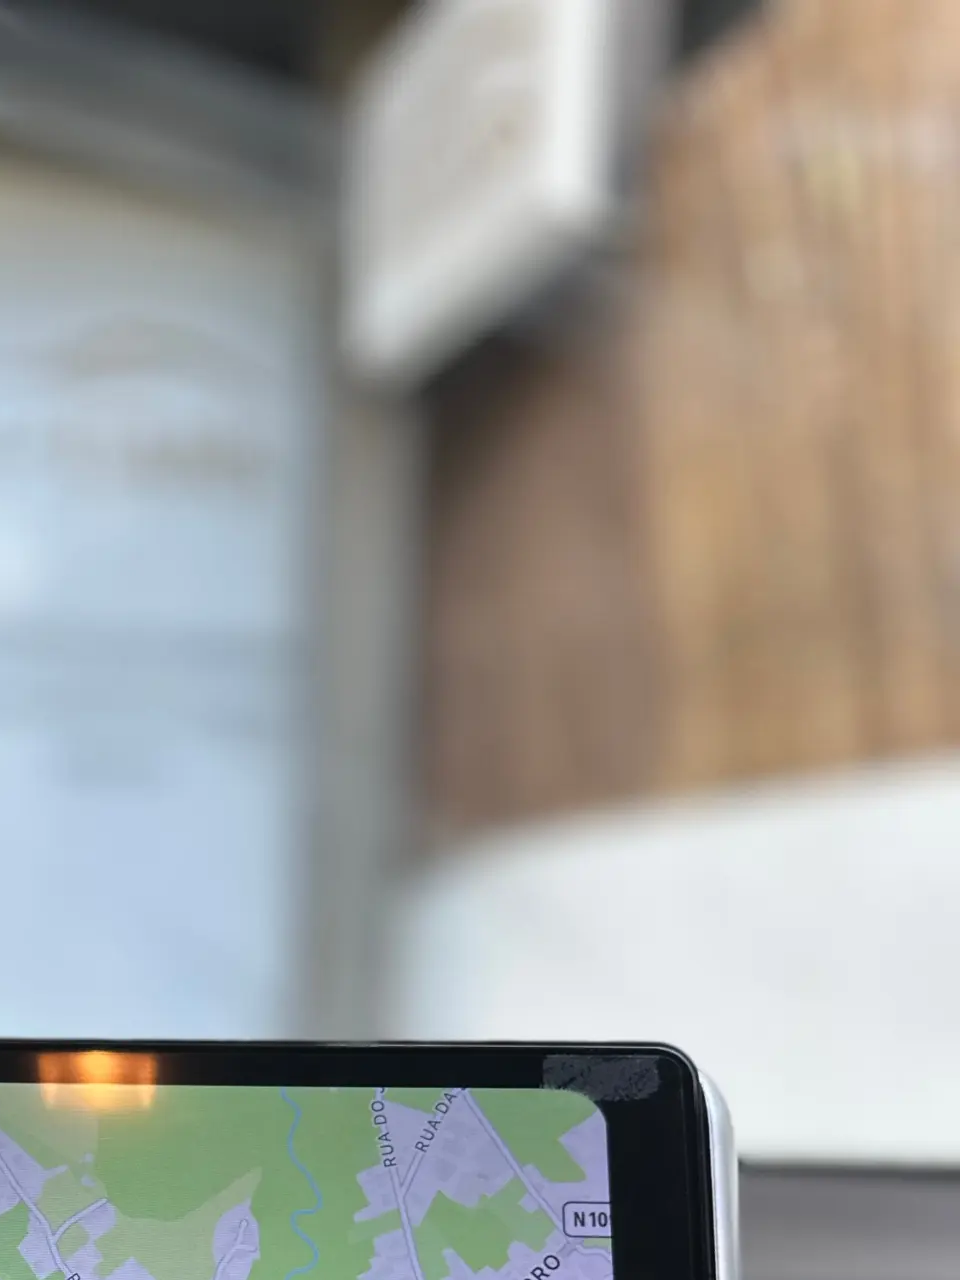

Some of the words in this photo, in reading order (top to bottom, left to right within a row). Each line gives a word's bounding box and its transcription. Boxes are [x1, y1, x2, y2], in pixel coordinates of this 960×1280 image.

[371, 1100, 387, 1125] DO
[415, 1120, 441, 1152] RUA
[435, 1093, 457, 1114] DA
[378, 1132, 397, 1167] RUA
[589, 1211, 610, 1228] 10
